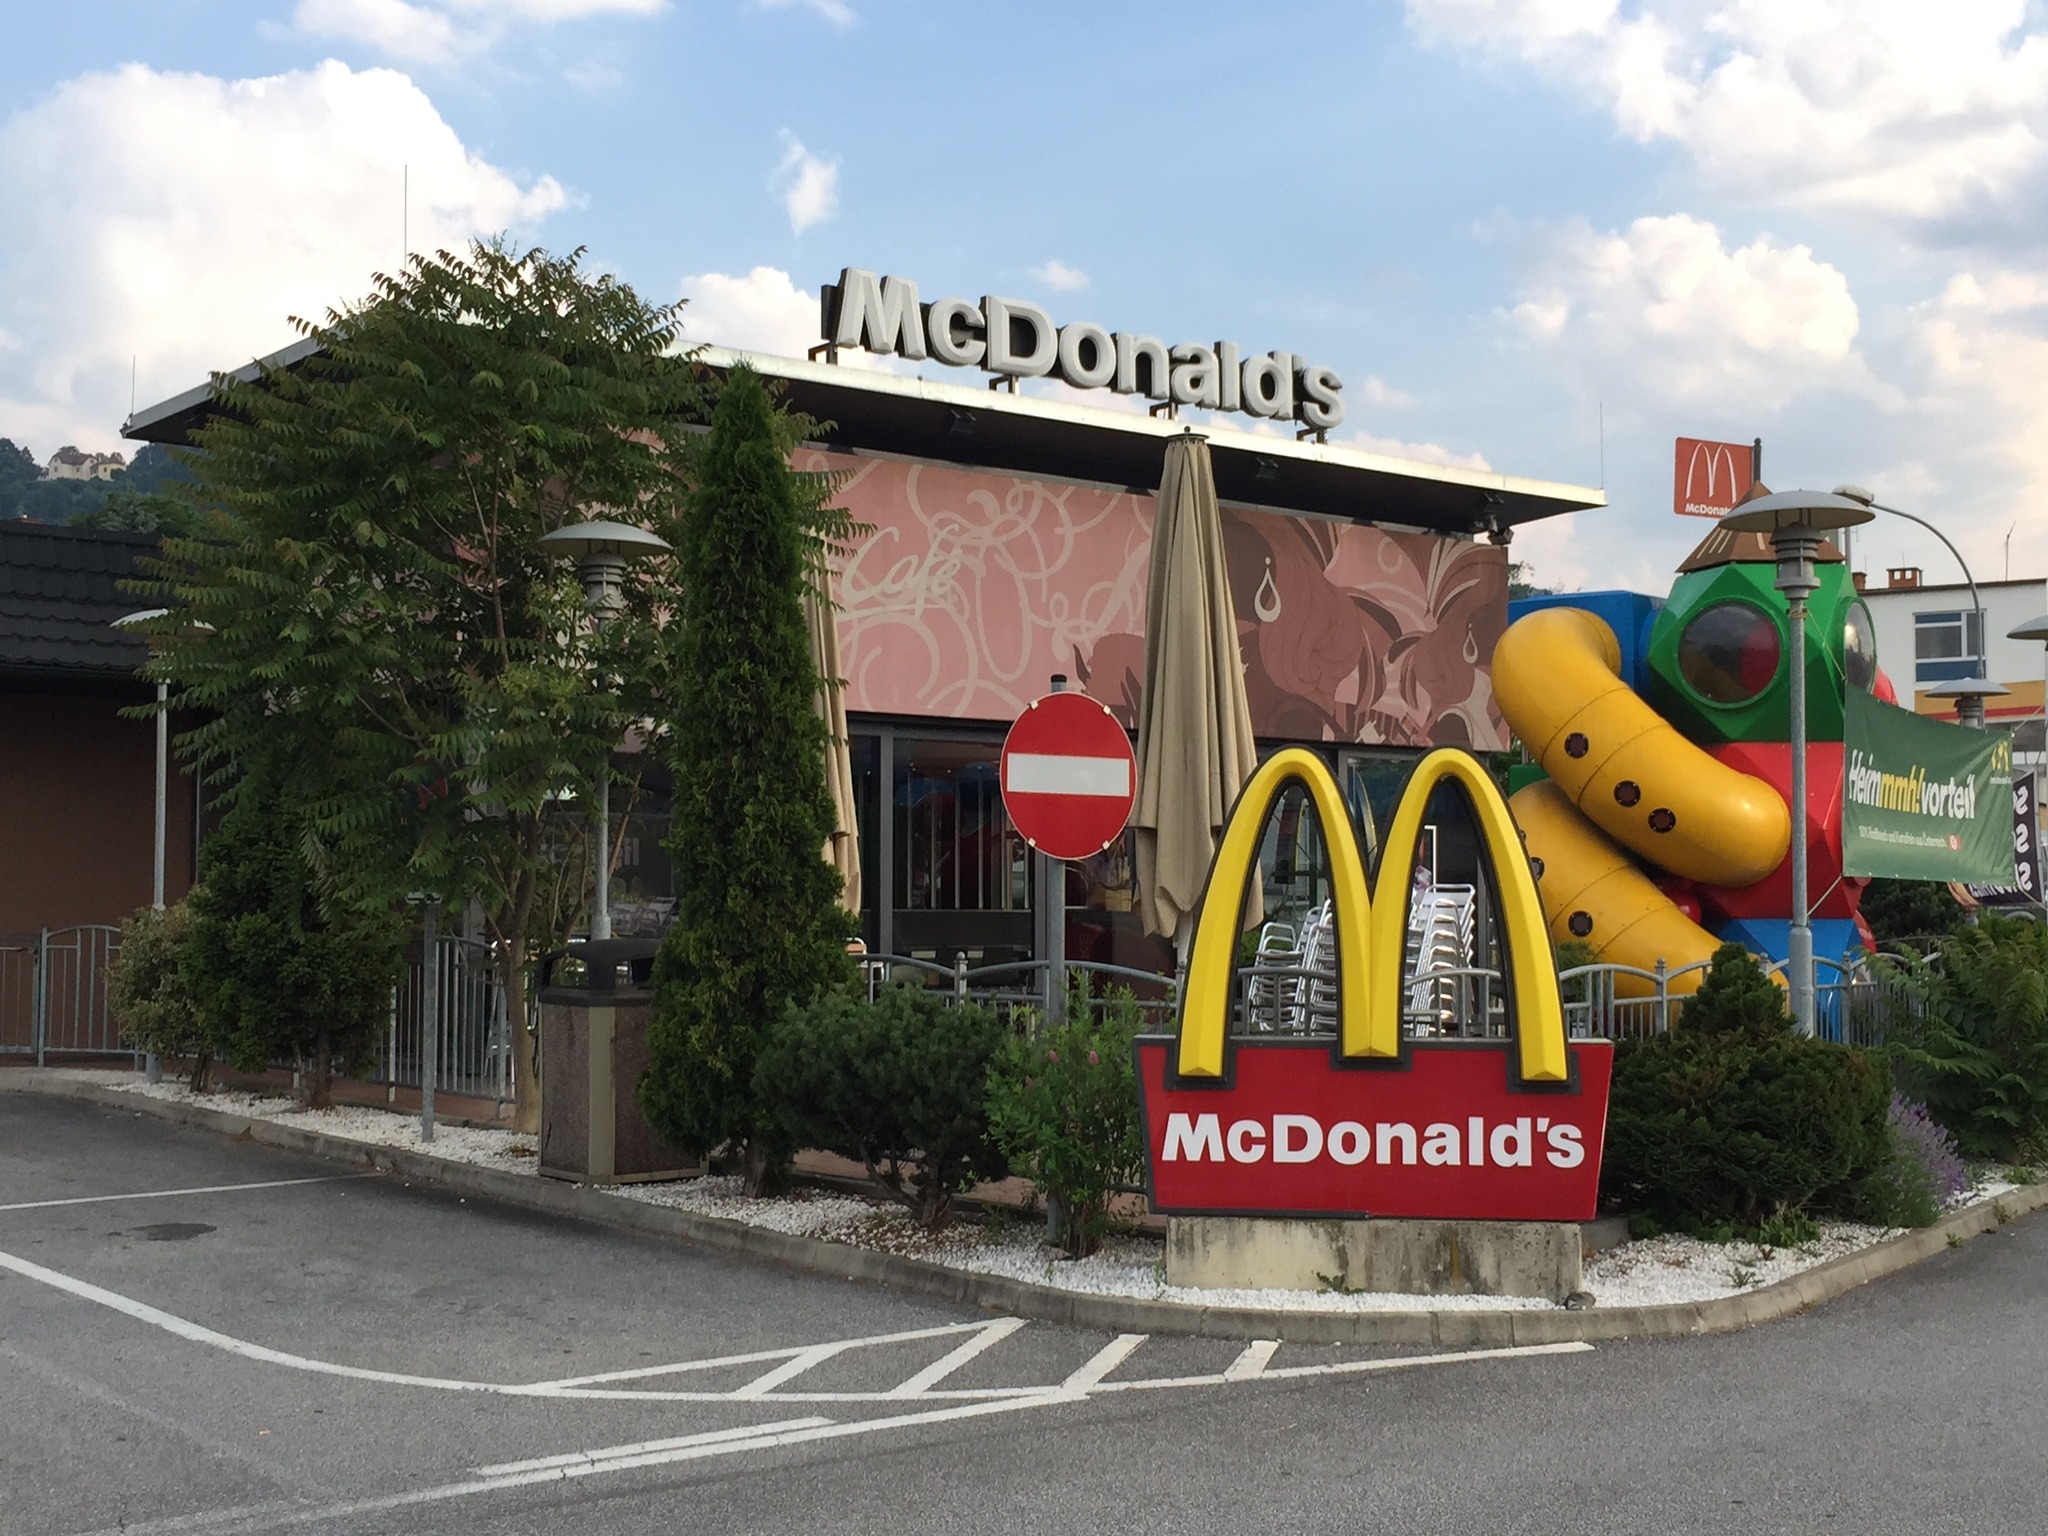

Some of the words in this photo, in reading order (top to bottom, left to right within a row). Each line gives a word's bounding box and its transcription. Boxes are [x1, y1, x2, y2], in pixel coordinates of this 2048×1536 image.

[834, 266, 1345, 428] McDonald's
[1685, 503, 1731, 516] McDonal
[1161, 1113, 1585, 1168] McDonald's
